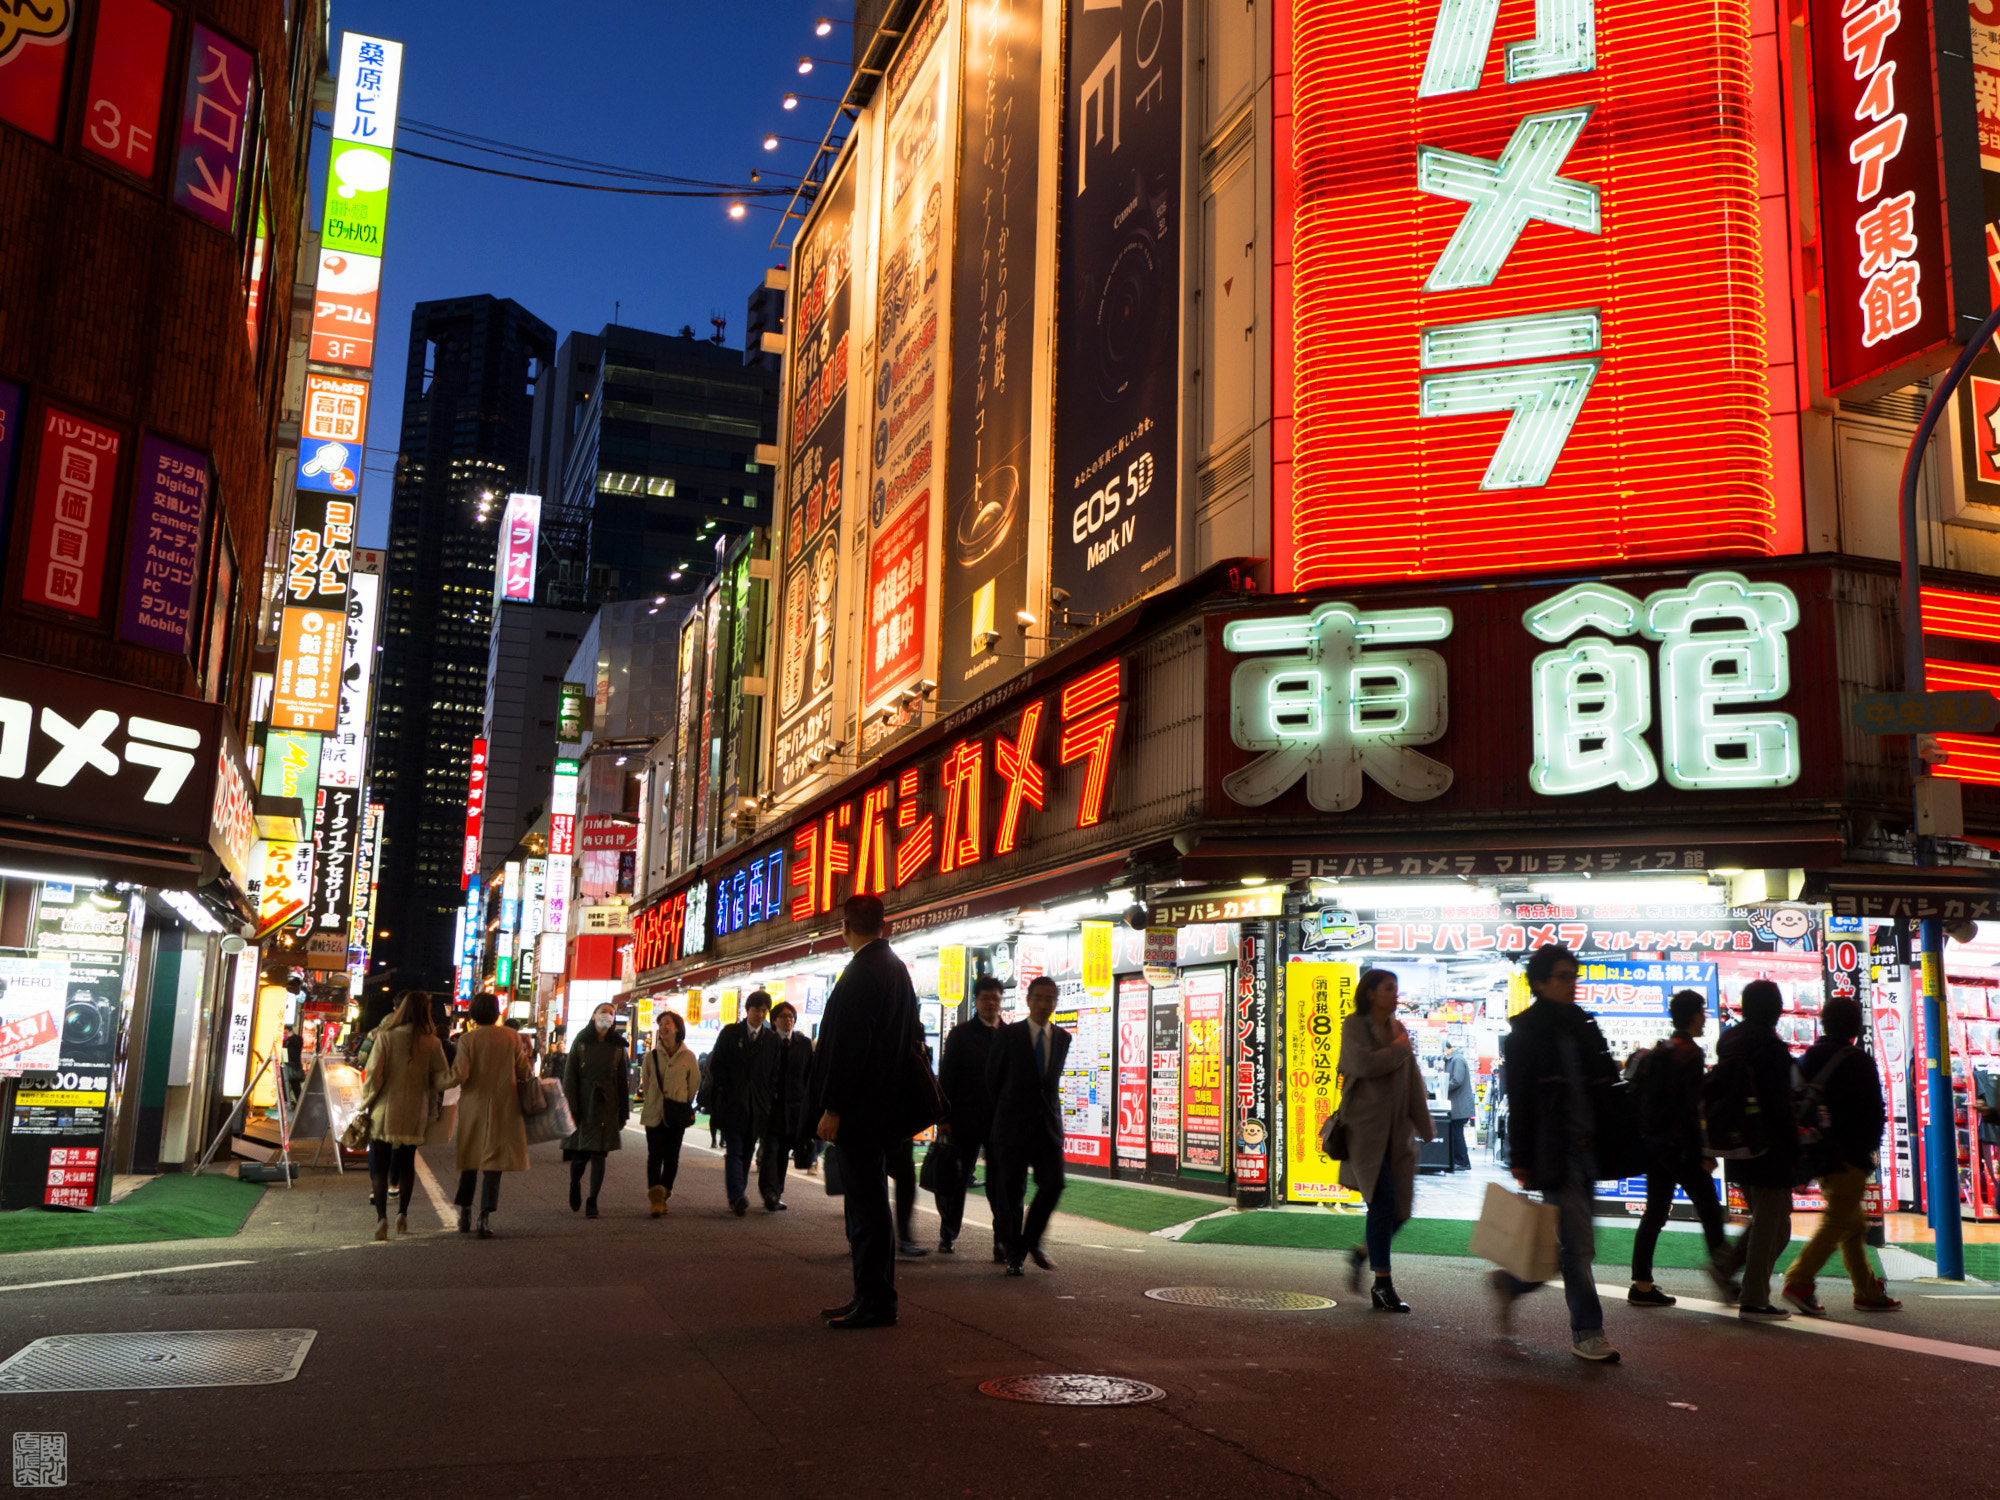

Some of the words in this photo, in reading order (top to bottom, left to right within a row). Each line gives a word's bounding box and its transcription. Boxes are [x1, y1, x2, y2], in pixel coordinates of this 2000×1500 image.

[197, 45, 242, 153] 入口
[351, 41, 384, 137] 桑原ビル
[90, 100, 152, 158] 3F
[328, 219, 378, 244] ピタットハウス
[1114, 197, 1138, 230] Canon
[317, 301, 371, 325] アコム
[327, 340, 356, 358] 3F
[315, 394, 356, 416] 高価
[793, 328, 849, 454] 商品知識
[314, 415, 354, 436] 買取
[156, 473, 199, 497] Digital
[332, 471, 354, 490] 2F
[1072, 477, 1121, 545] EOS
[1125, 451, 1155, 507] 5D
[46, 446, 98, 606] 高価買取
[787, 456, 841, 564] 品揃え
[290, 529, 320, 600] カメラ
[319, 500, 354, 594] ヨドバシ
[508, 502, 532, 592] カラオケ
[1087, 528, 1120, 572] Mark
[1120, 514, 1136, 552] IV
[143, 578, 162, 594] PC
[871, 541, 924, 627] 新規会員
[138, 612, 184, 635] Mobile
[874, 602, 914, 673] 募集中
[293, 713, 315, 727] B1
[1222, 571, 1801, 813] 東館
[1865, 698, 1989, 728] 中央通り
[776, 699, 833, 769] ヨドバシカメラ
[468, 752, 485, 818] カラオケ
[791, 654, 1121, 922] ヨドバシカメラ
[263, 845, 293, 906] らーめん
[296, 847, 312, 884] 手打ち
[321, 791, 352, 929] ケータイアクセサリー館
[1291, 856, 1476, 877] ヨドバシカメラ
[1493, 849, 1705, 873] マルチメディア館
[716, 849, 783, 937] 新宿西口
[1154, 897, 1277, 926] ヨドバシカメラ
[1375, 922, 1589, 952] ヨドバシカメラ
[1592, 930, 1753, 951] マルチメディア館
[1120, 1022, 1146, 1066] 8%
[1187, 1054, 1220, 1089] 商店
[1120, 1089, 1145, 1135] 5%
